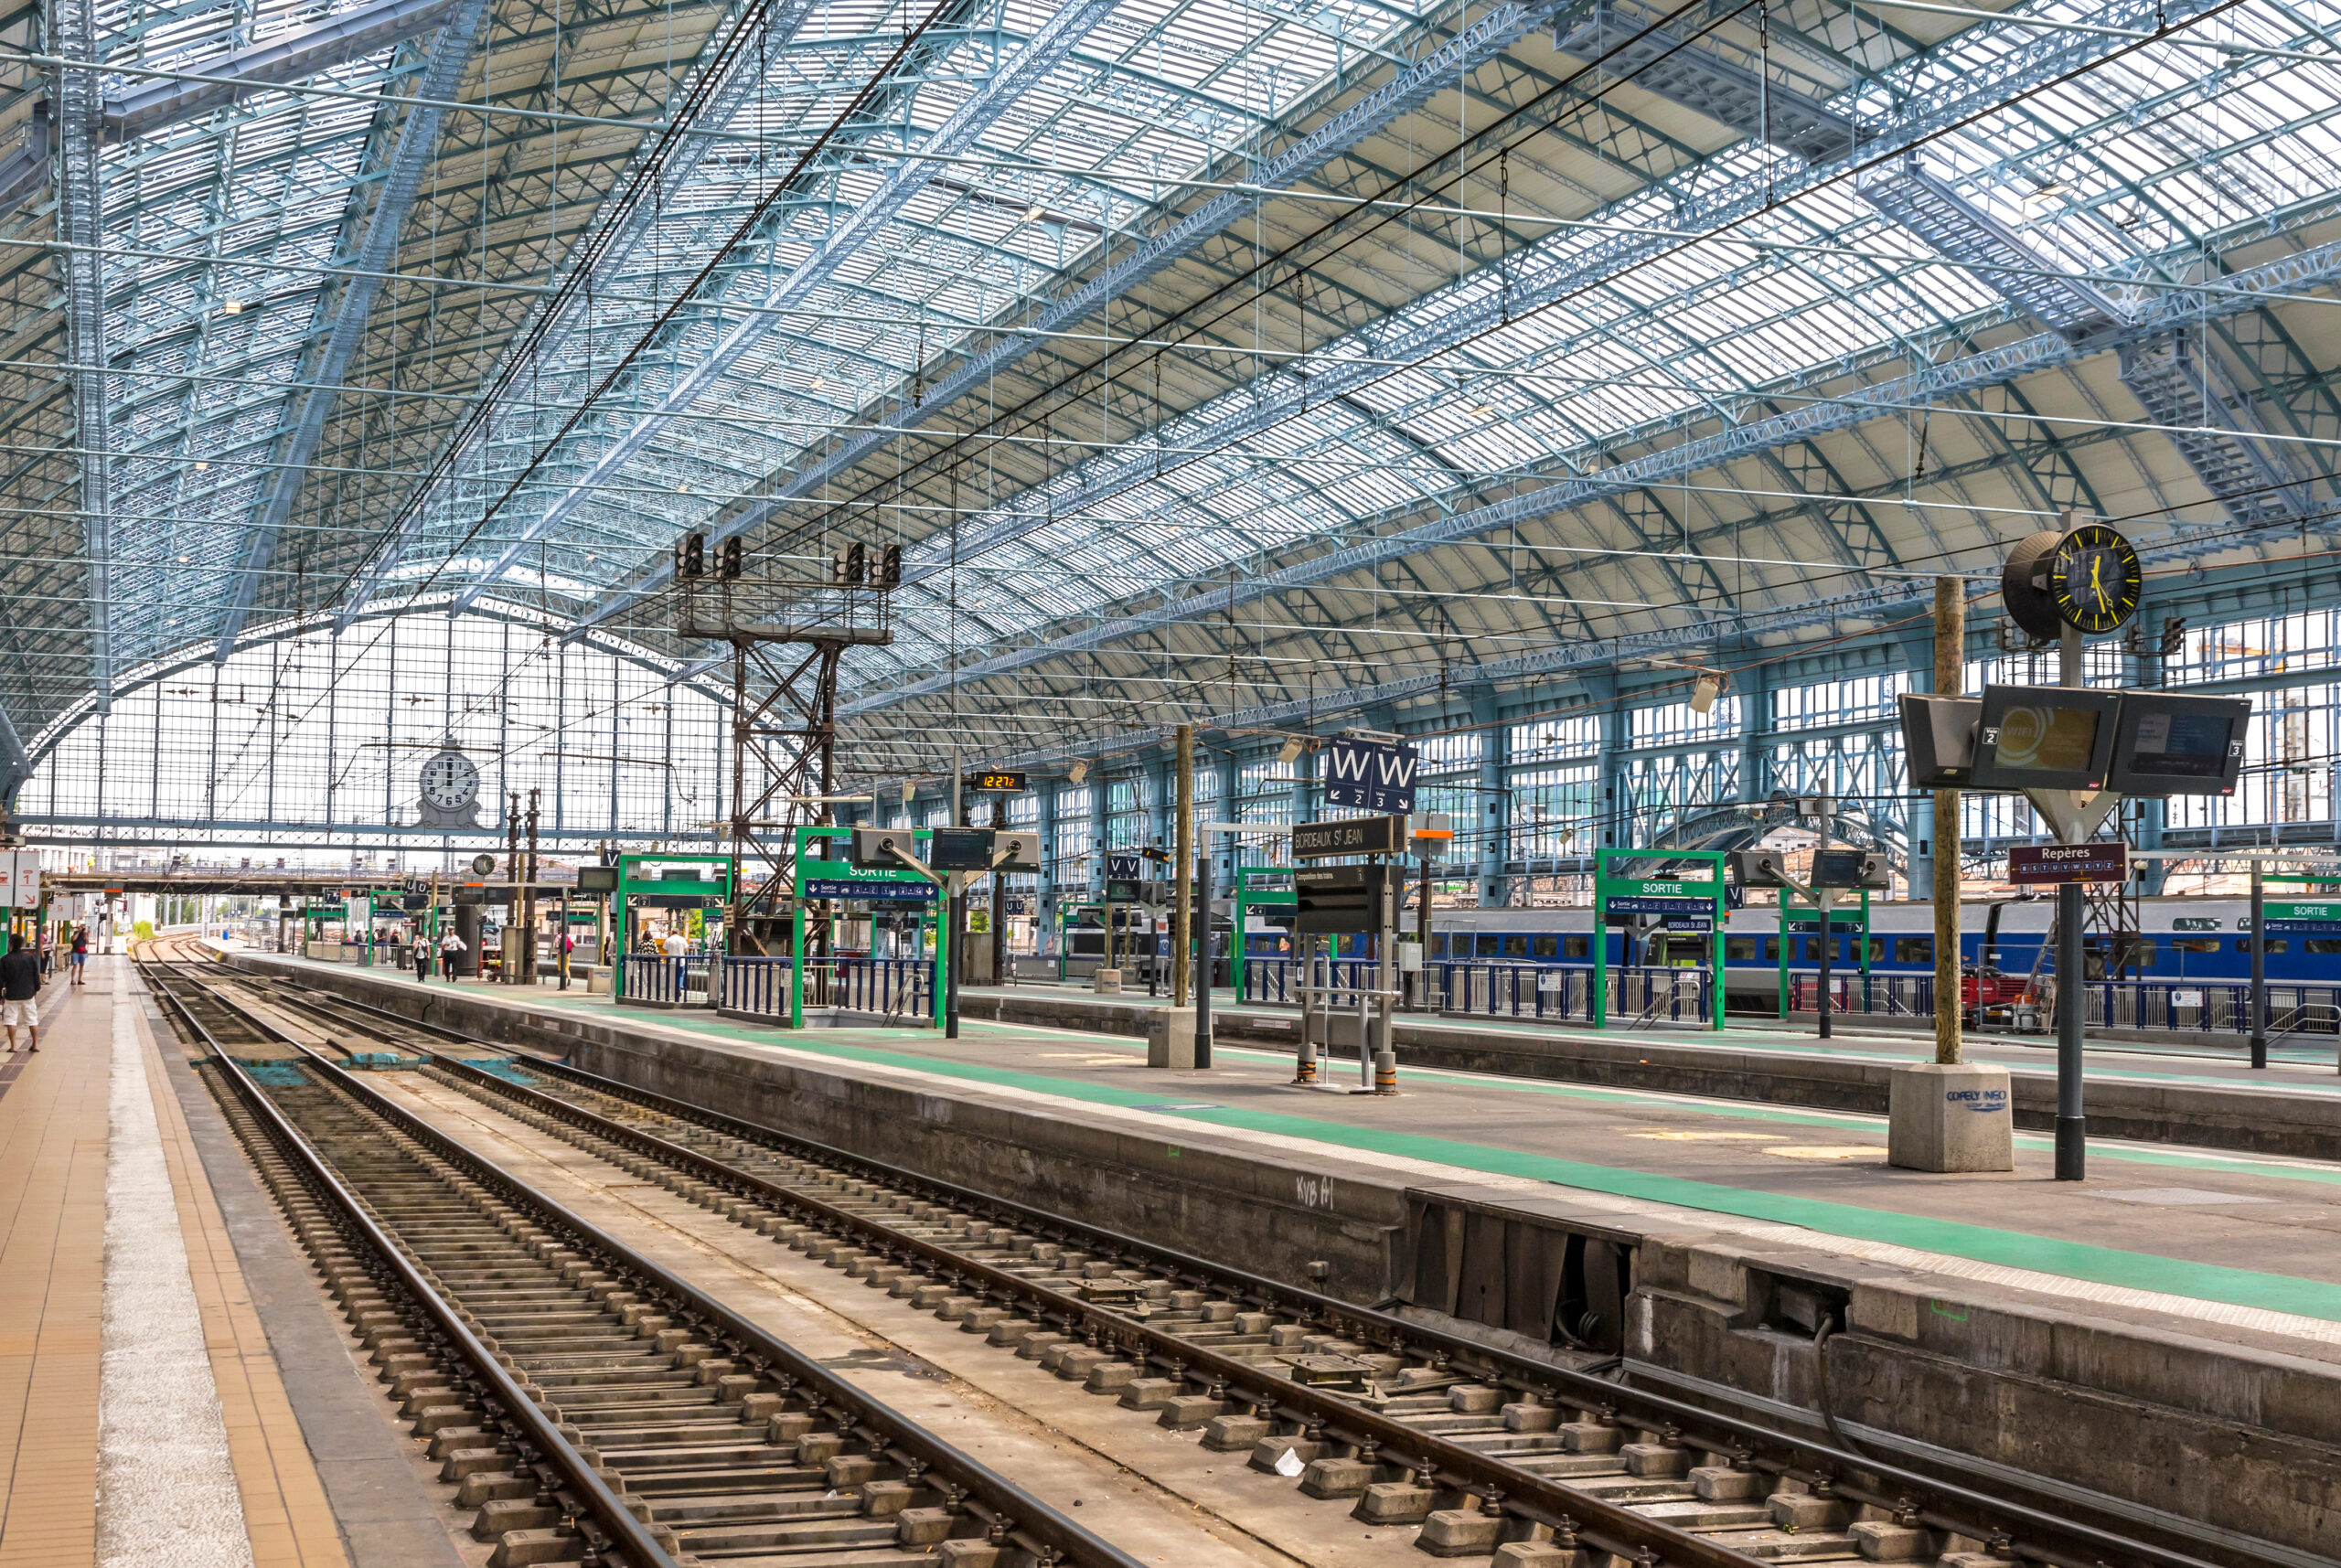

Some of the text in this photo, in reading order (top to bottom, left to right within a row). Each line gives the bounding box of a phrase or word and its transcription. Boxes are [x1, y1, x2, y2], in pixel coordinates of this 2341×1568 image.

[1987, 734, 1994, 743] 2
[2232, 746, 2239, 755] 3
[1332, 746, 1416, 788] W W
[436, 794, 443, 803] 7
[446, 796, 452, 805] 6
[455, 795, 462, 804] 5
[1355, 795, 1362, 805] 2
[1376, 797, 1384, 807] 3
[1295, 831, 1331, 848] BORDEAUX
[1343, 828, 1363, 846] JEAN
[2042, 848, 2090, 861] Repères
[607, 853, 618, 867] V
[1111, 859, 1137, 872] V V
[24, 875, 28, 885] 1
[419, 883, 426, 892] U
[1642, 883, 1683, 894] SORTIE
[1729, 888, 1739, 900] V
[2293, 906, 2327, 916] SORTIE
